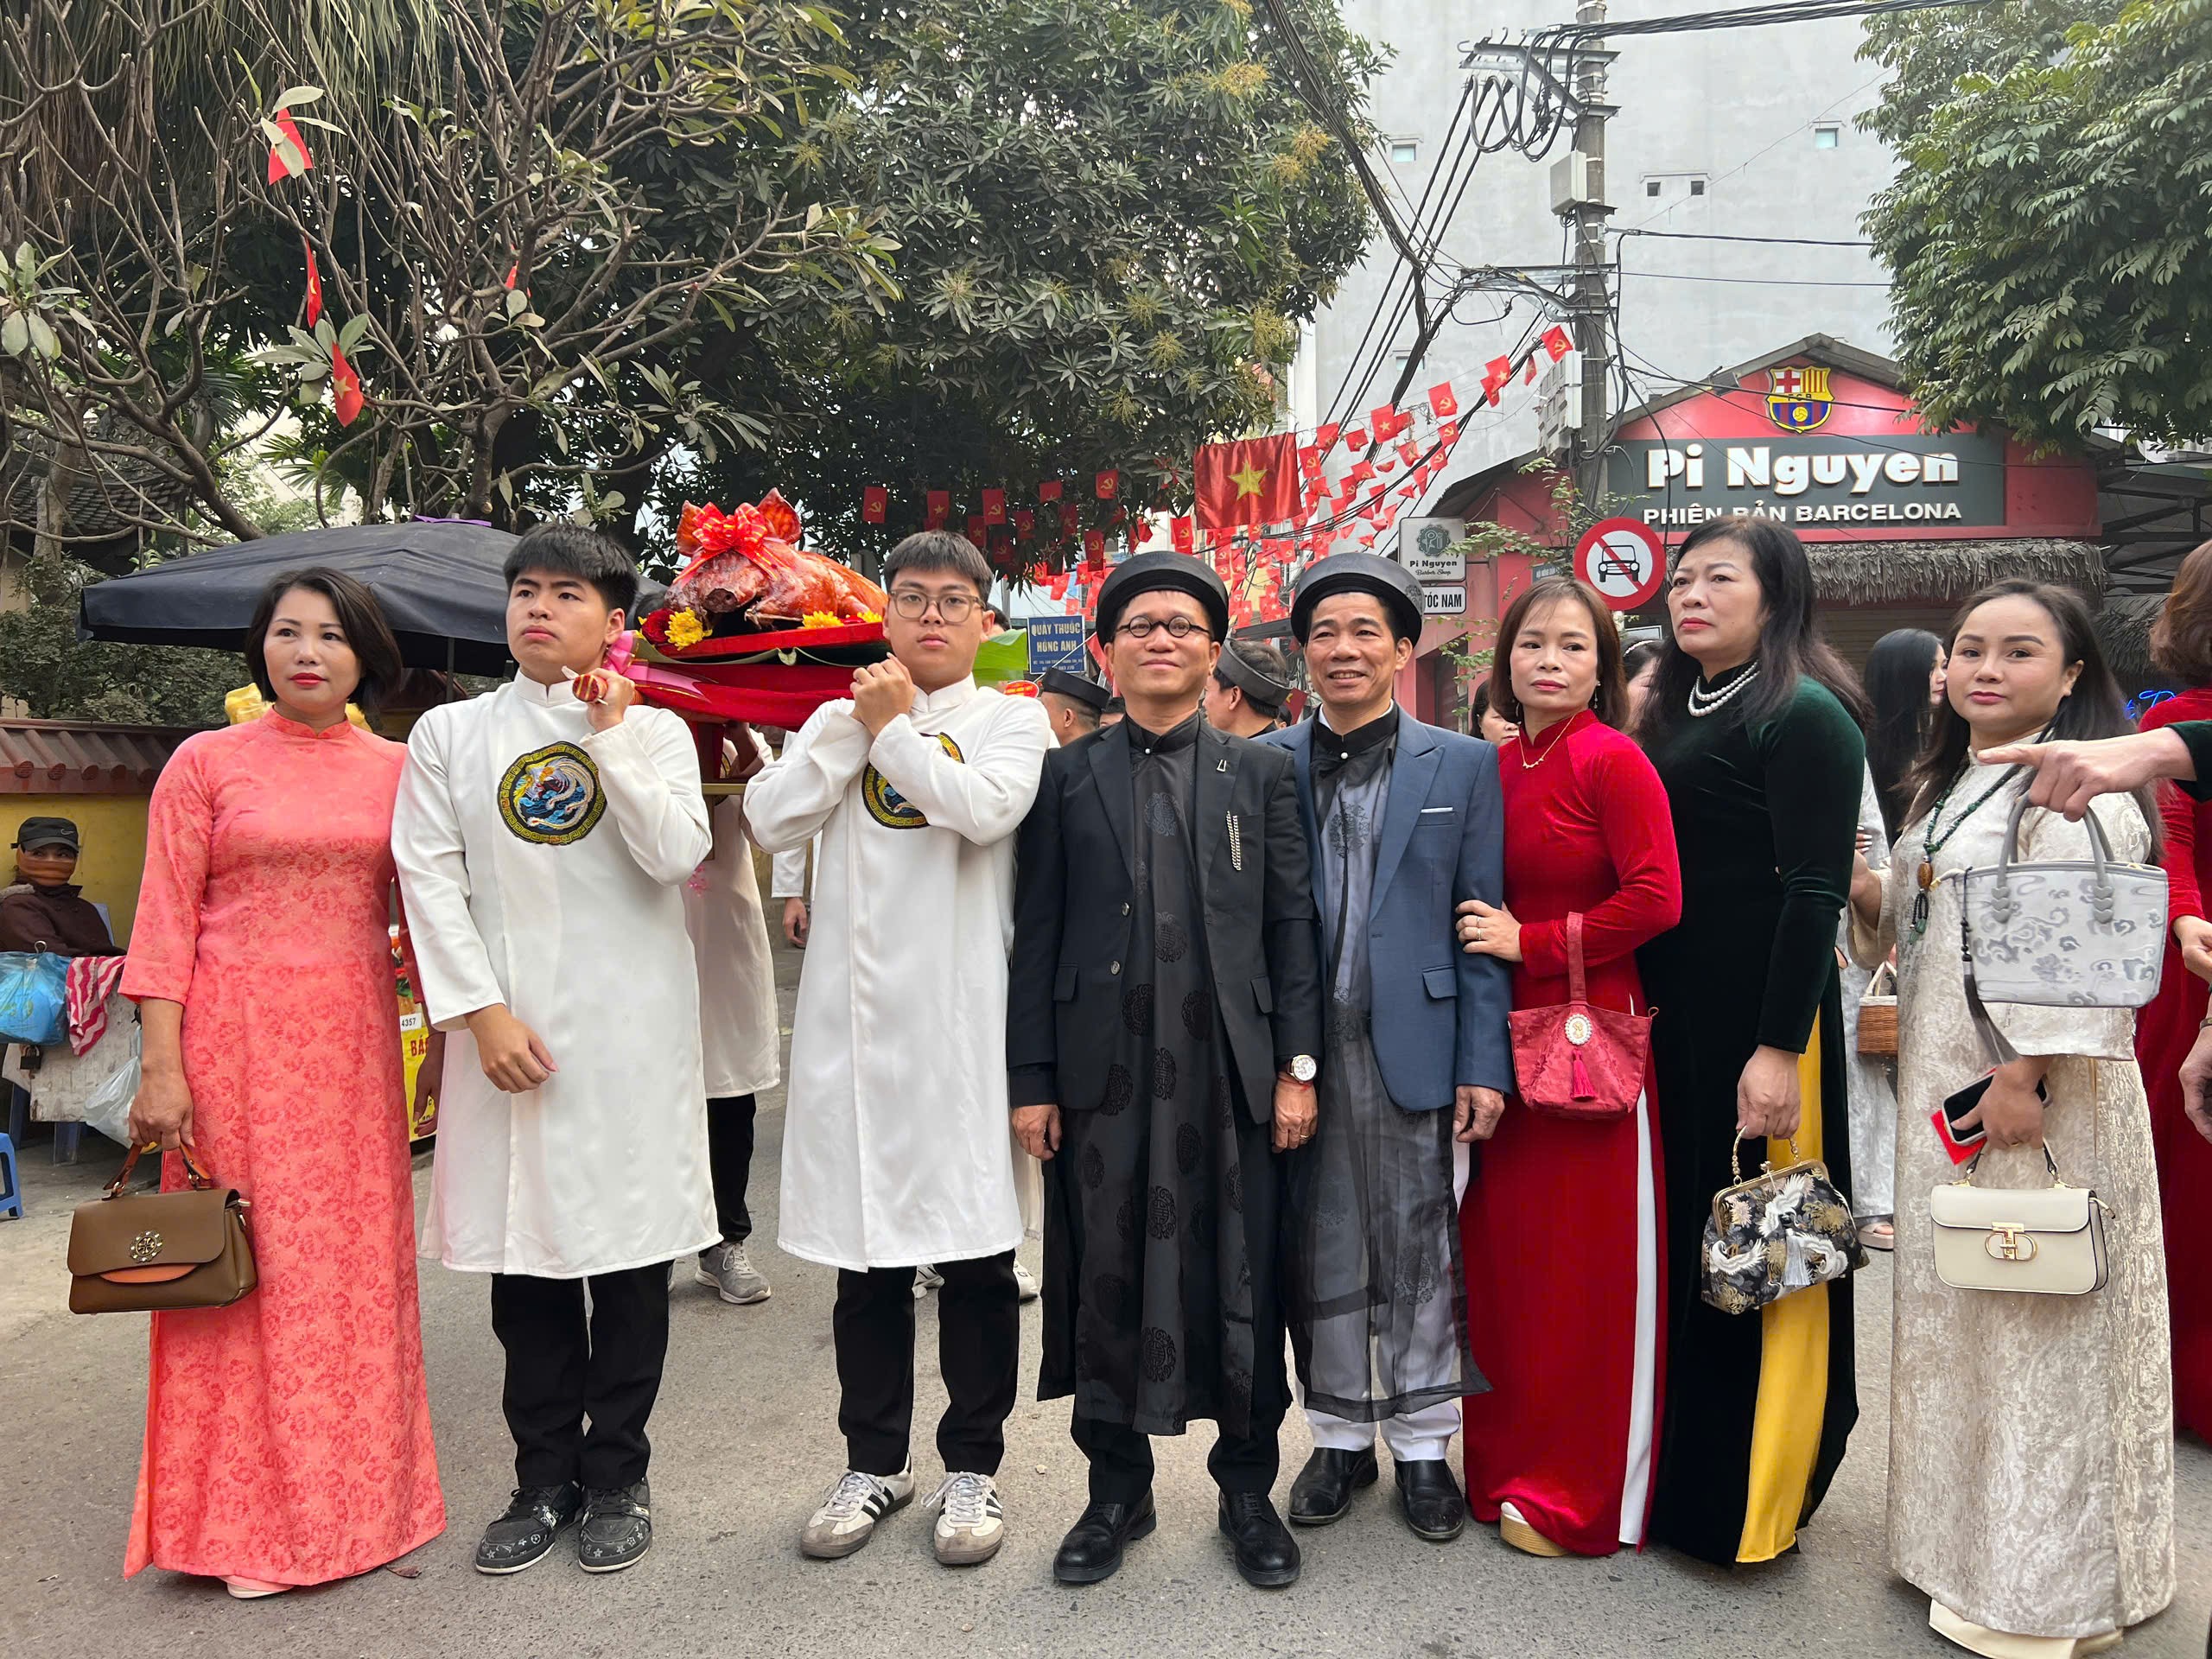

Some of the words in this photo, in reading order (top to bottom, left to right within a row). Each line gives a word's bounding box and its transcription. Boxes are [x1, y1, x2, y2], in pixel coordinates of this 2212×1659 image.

[1647, 443, 1704, 487] Pi
[1726, 446, 1960, 495] Nguyen
[1643, 503, 1722, 524] PHIÊN
[1796, 502, 1961, 522] BARCELONA
[1441, 594, 1462, 607] NAM
[401, 1017, 416, 1027] 4357
